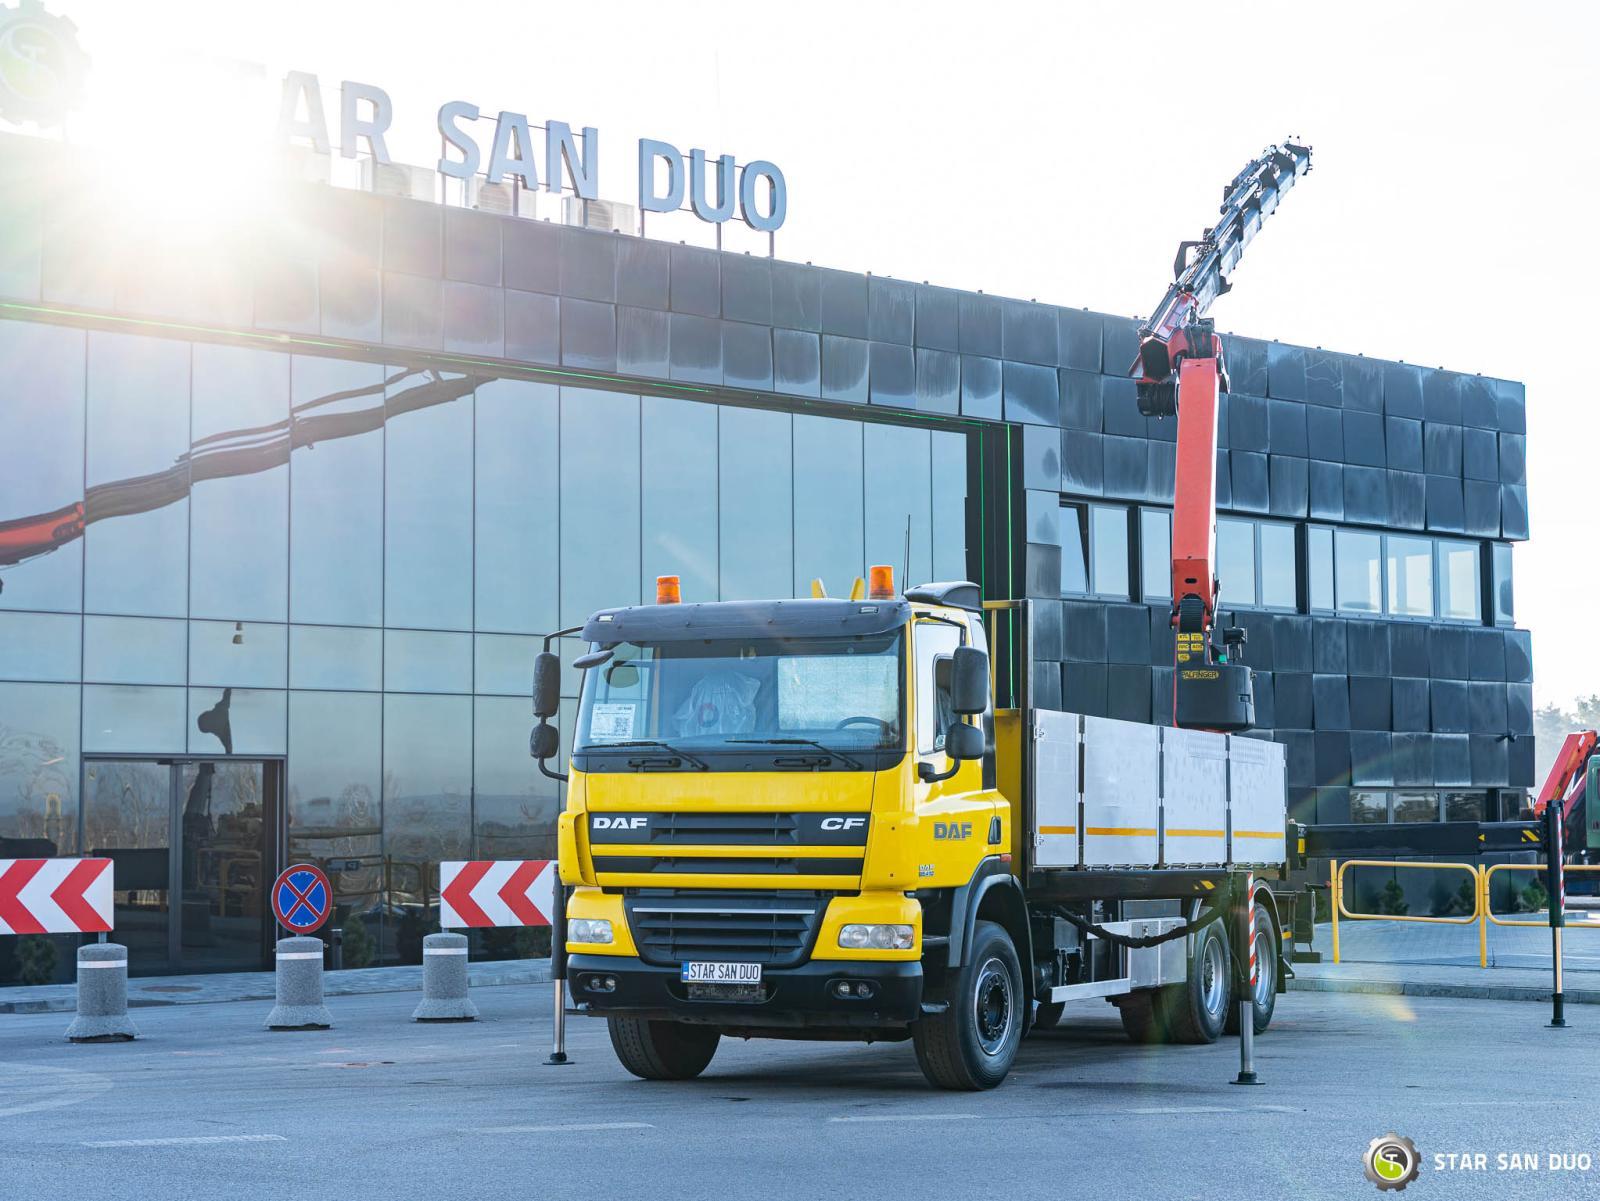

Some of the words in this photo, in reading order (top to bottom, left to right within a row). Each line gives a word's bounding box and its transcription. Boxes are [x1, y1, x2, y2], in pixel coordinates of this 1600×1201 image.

[437, 100, 599, 201] SAN
[638, 137, 787, 232] DUO
[592, 816, 648, 830] DAF
[820, 816, 866, 831] CF
[933, 821, 973, 840] DAF
[690, 963, 716, 979] STAR
[718, 964, 738, 980] SAN
[739, 964, 759, 980] DUO
